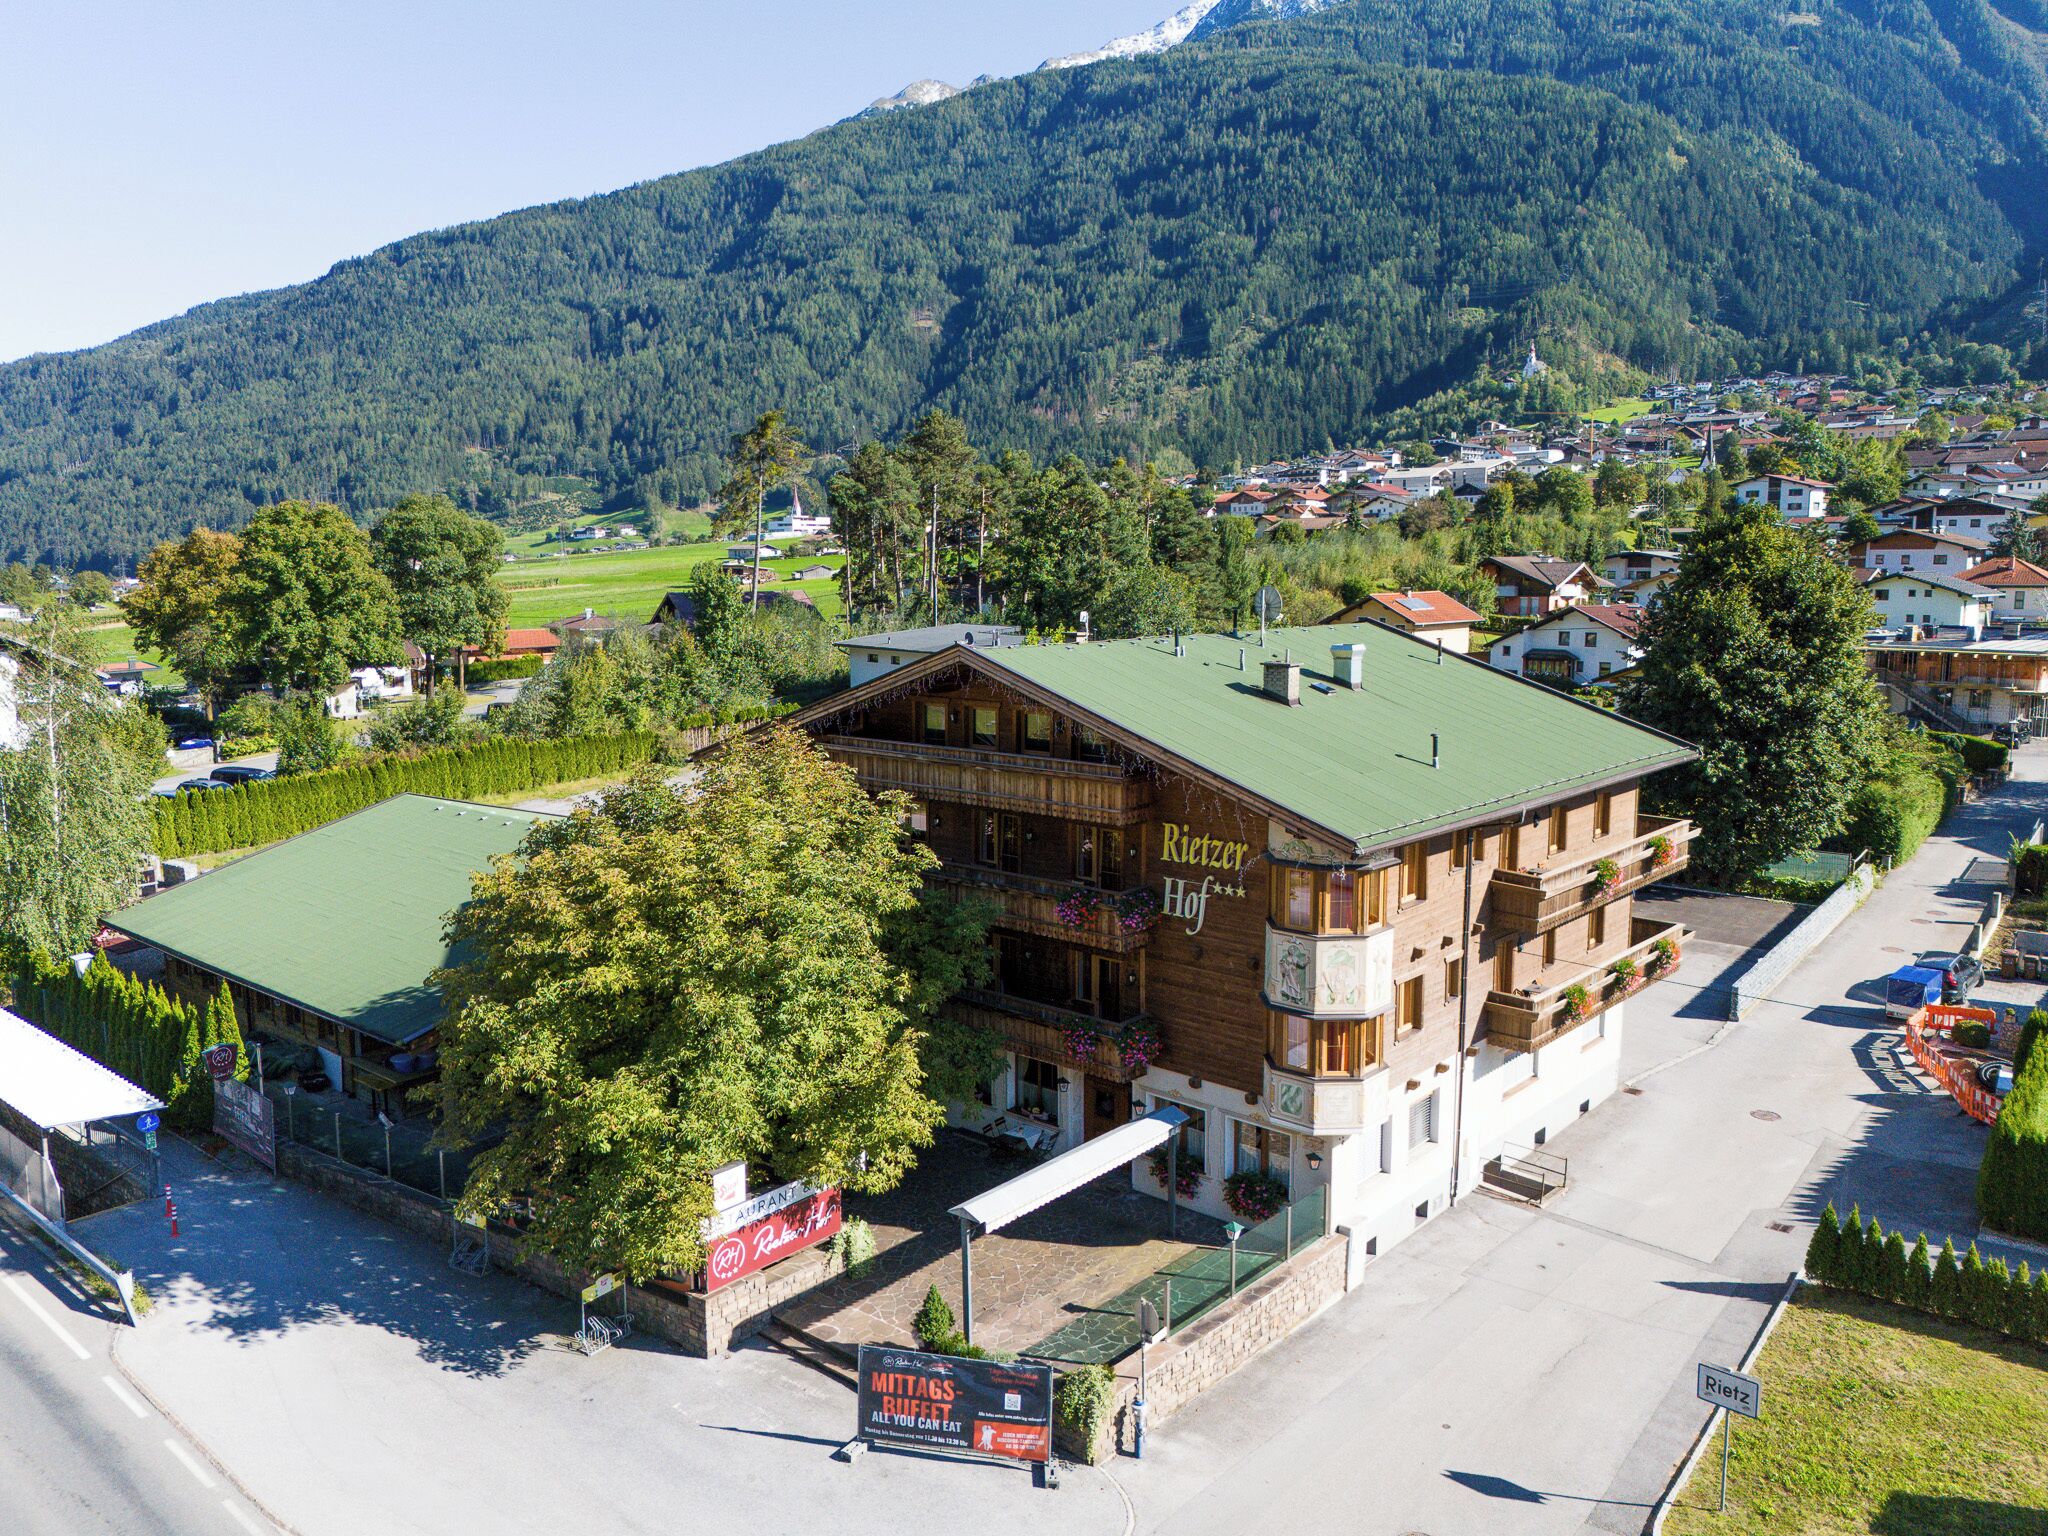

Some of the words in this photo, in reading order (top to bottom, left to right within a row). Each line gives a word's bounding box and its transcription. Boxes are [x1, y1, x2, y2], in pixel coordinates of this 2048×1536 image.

[1160, 822, 1249, 872] Rietzer
[1161, 875, 1215, 936] Hof
[753, 1224, 805, 1260] Rietzer
[803, 1201, 837, 1238] Hof
[717, 1243, 741, 1272] RH
[871, 1371, 964, 1402] MITTAGS-
[1705, 1374, 1751, 1405] Rietz
[871, 1410, 890, 1424] ALL
[893, 1414, 915, 1428] YOU
[917, 1417, 940, 1431] CAN
[942, 1421, 962, 1433] EAT
[882, 1395, 953, 1422] BUFFET
[864, 1426, 881, 1435] Montag
